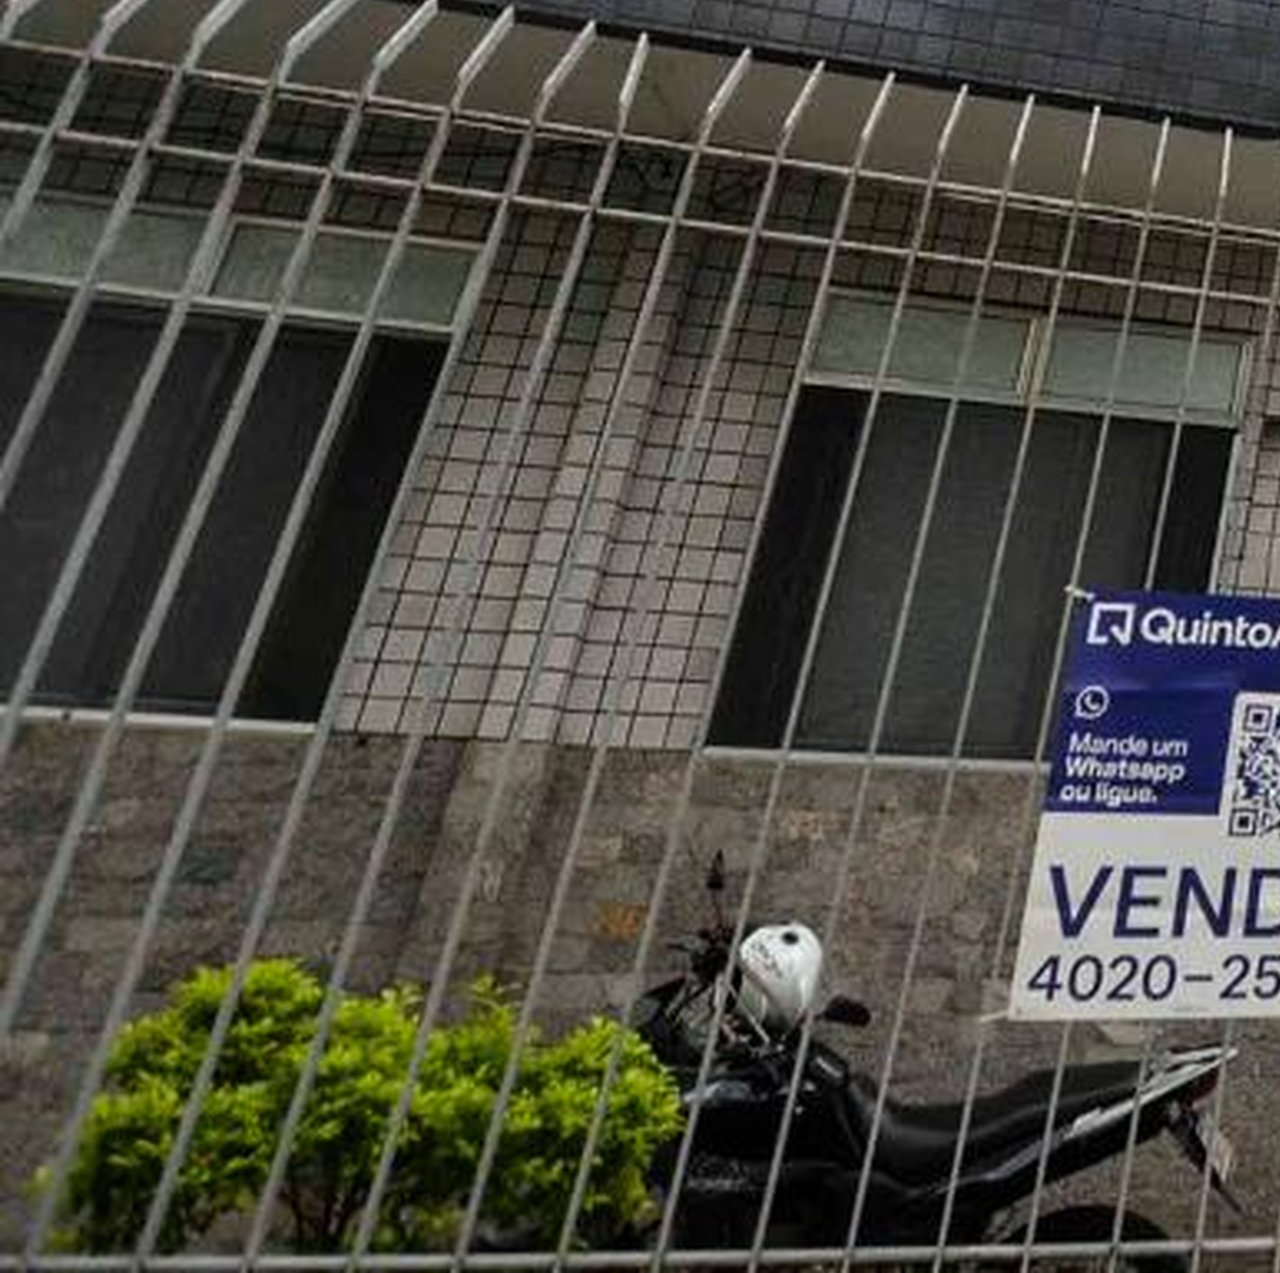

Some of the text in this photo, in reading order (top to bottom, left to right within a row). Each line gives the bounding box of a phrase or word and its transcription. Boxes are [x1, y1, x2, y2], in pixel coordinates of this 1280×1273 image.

[1069, 731, 1188, 757] Mande um
[1065, 756, 1186, 785] Whatsapp
[1060, 781, 1158, 807] ou ligue.
